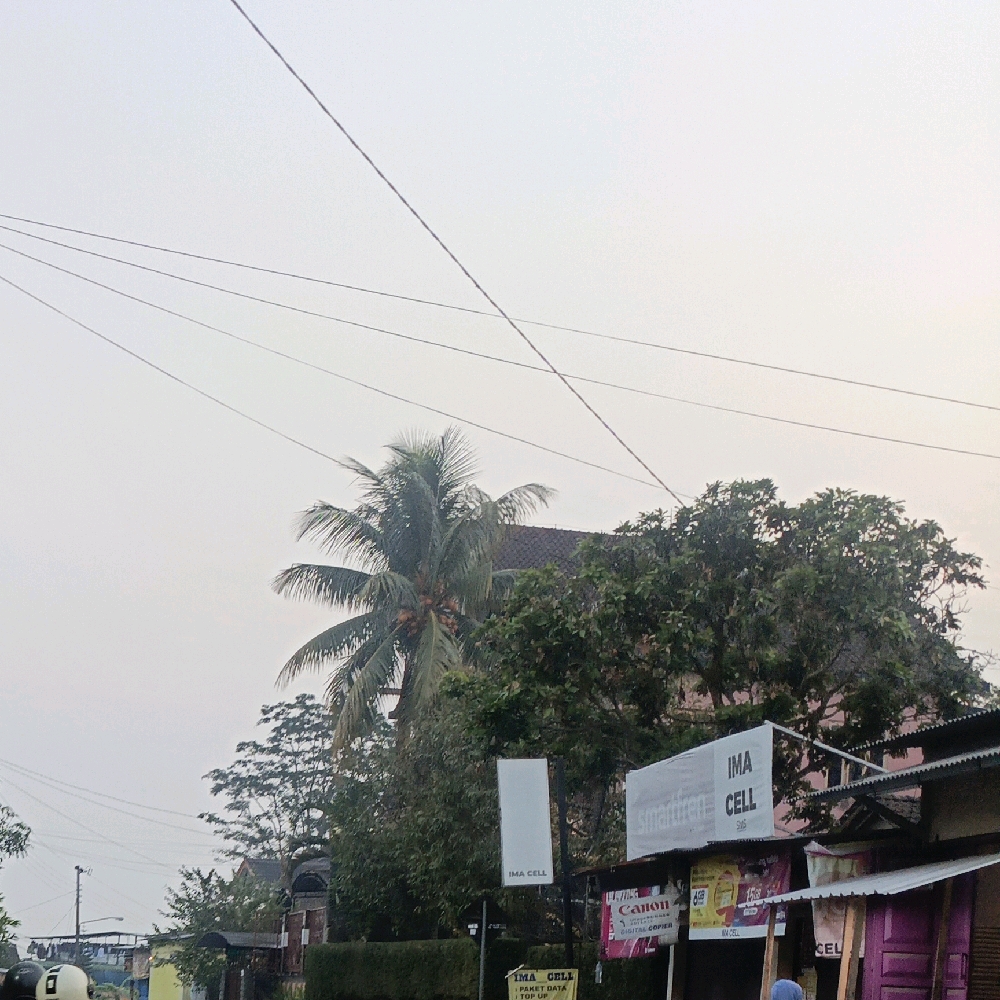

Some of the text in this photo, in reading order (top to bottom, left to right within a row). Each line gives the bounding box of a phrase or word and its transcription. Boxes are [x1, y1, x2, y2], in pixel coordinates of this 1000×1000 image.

[728, 750, 752, 779] IMA
[725, 788, 756, 817] CELL
[618, 900, 669, 916] Canon
[816, 943, 842, 954] CEL
[514, 972, 574, 982] IMA CELL
